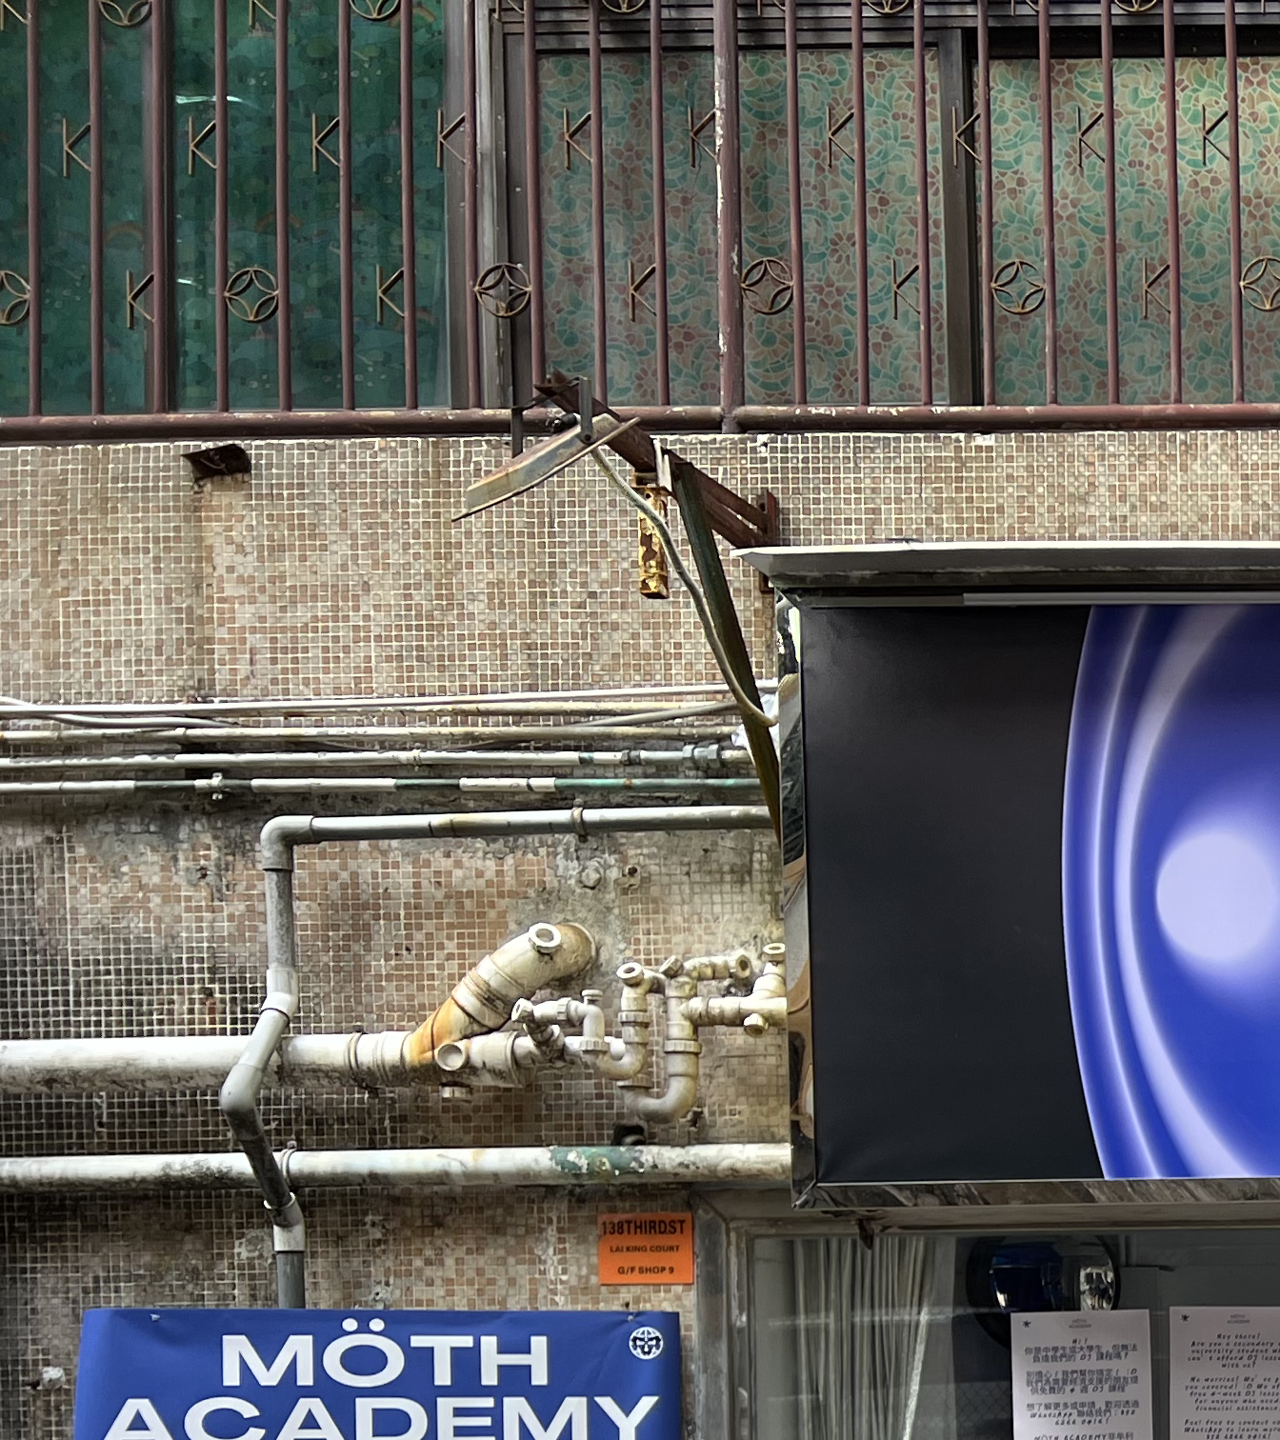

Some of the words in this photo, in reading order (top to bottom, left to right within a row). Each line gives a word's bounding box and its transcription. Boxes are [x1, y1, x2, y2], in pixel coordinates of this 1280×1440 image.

[609, 1245, 624, 1253] LAI
[625, 1245, 648, 1253] KING
[617, 1266, 636, 1275] G/F
[638, 1266, 666, 1275] SHOP
[668, 1266, 675, 1274] 9
[222, 1318, 549, 1388] MÖTH
